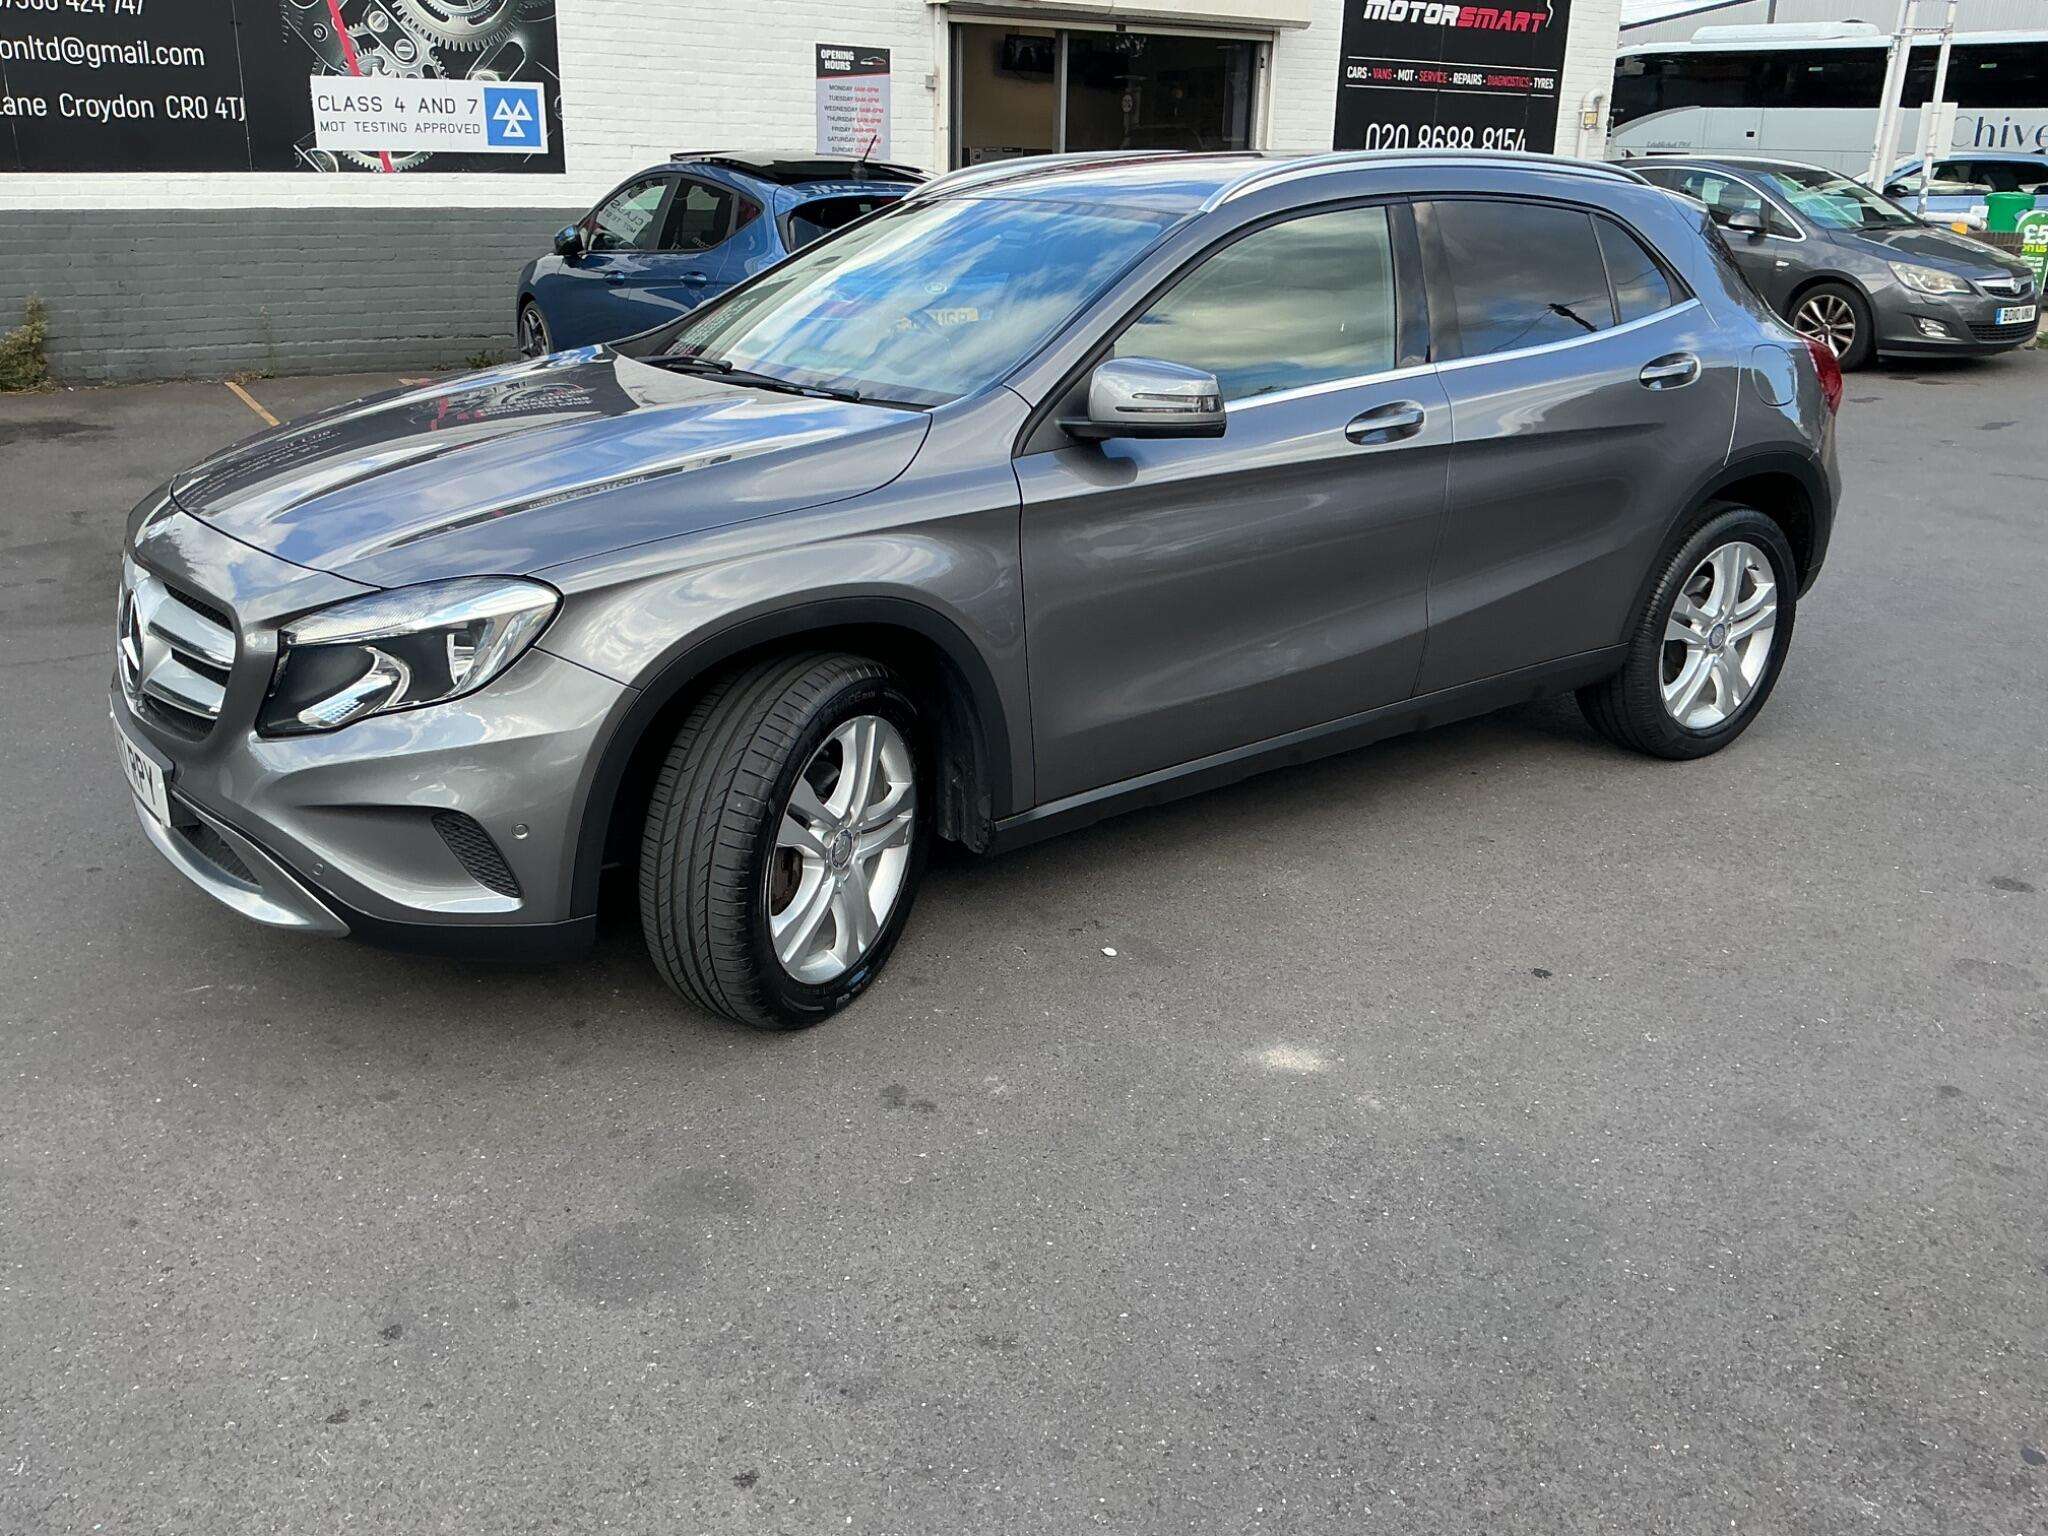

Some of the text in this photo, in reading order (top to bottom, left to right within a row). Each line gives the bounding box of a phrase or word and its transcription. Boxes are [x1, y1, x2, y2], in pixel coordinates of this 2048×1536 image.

[1363, 0, 1547, 33] MOTORSMART
[820, 49, 855, 61] OPENING
[824, 60, 851, 71] HOURS
[1347, 66, 1554, 89] CARS VANS MOT SERVICE REPAIRS DIAGNOSTICS TYRES
[59, 93, 154, 123] Croydon
[215, 96, 247, 121] 4TJ
[318, 95, 478, 115] CLASS 4 AND 7
[320, 120, 481, 134] MOT TESTING APPROVED
[1365, 123, 1526, 151] 020 8688 8154
